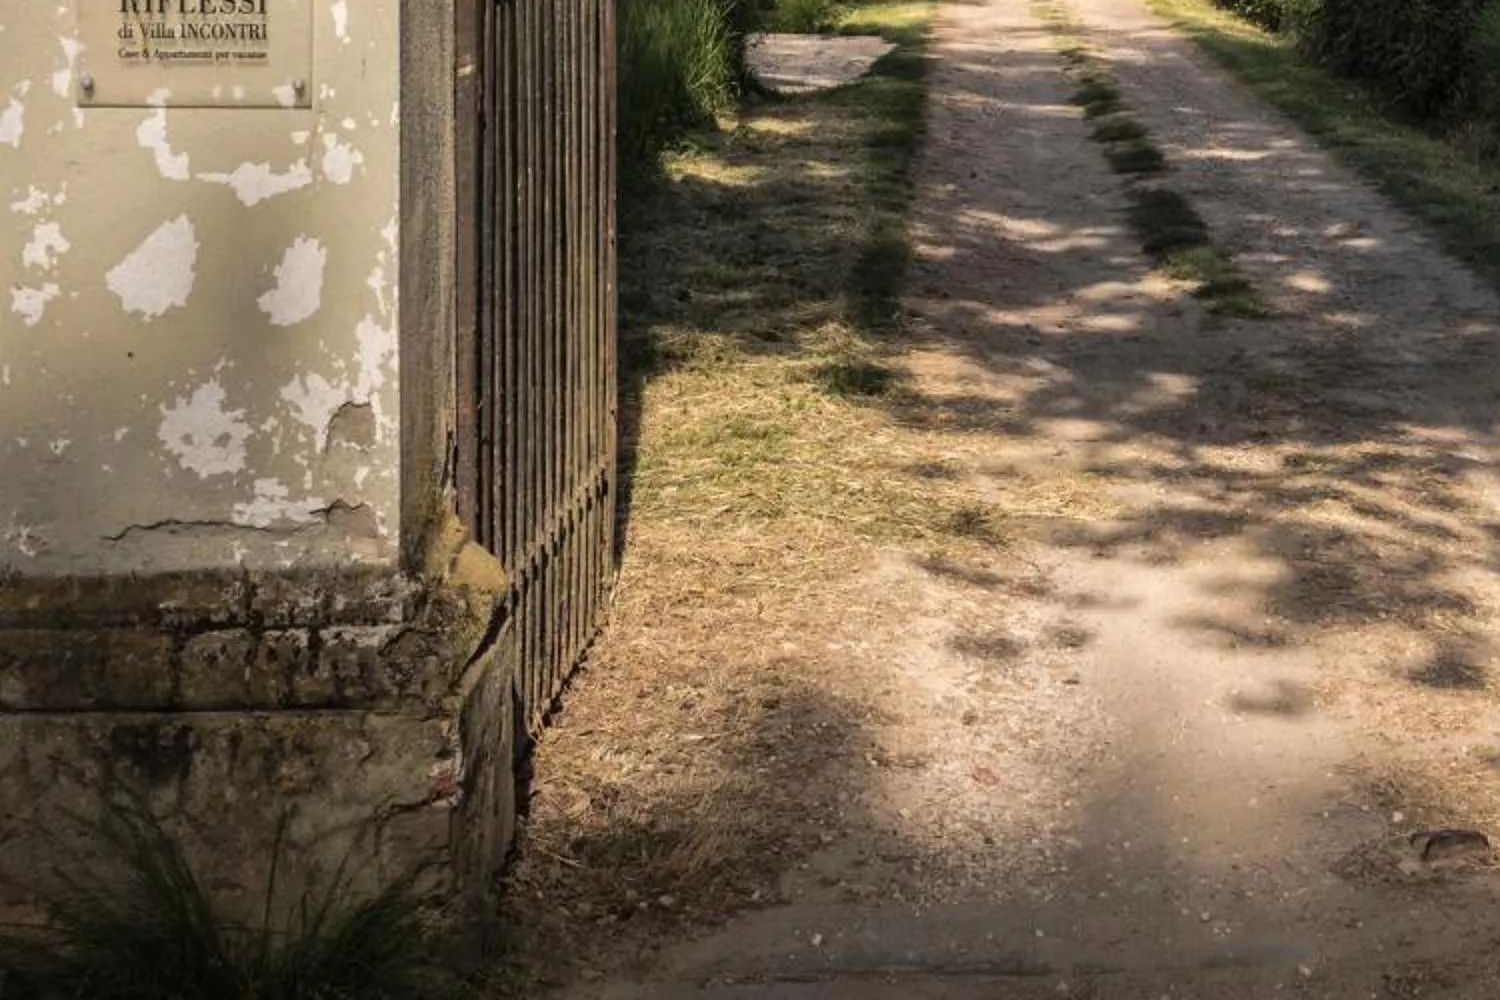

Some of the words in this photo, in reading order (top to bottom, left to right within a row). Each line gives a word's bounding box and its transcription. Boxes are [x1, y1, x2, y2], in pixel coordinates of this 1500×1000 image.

[117, 23, 132, 40] di
[139, 23, 175, 40] Villa
[180, 23, 267, 41] INCONTRI
